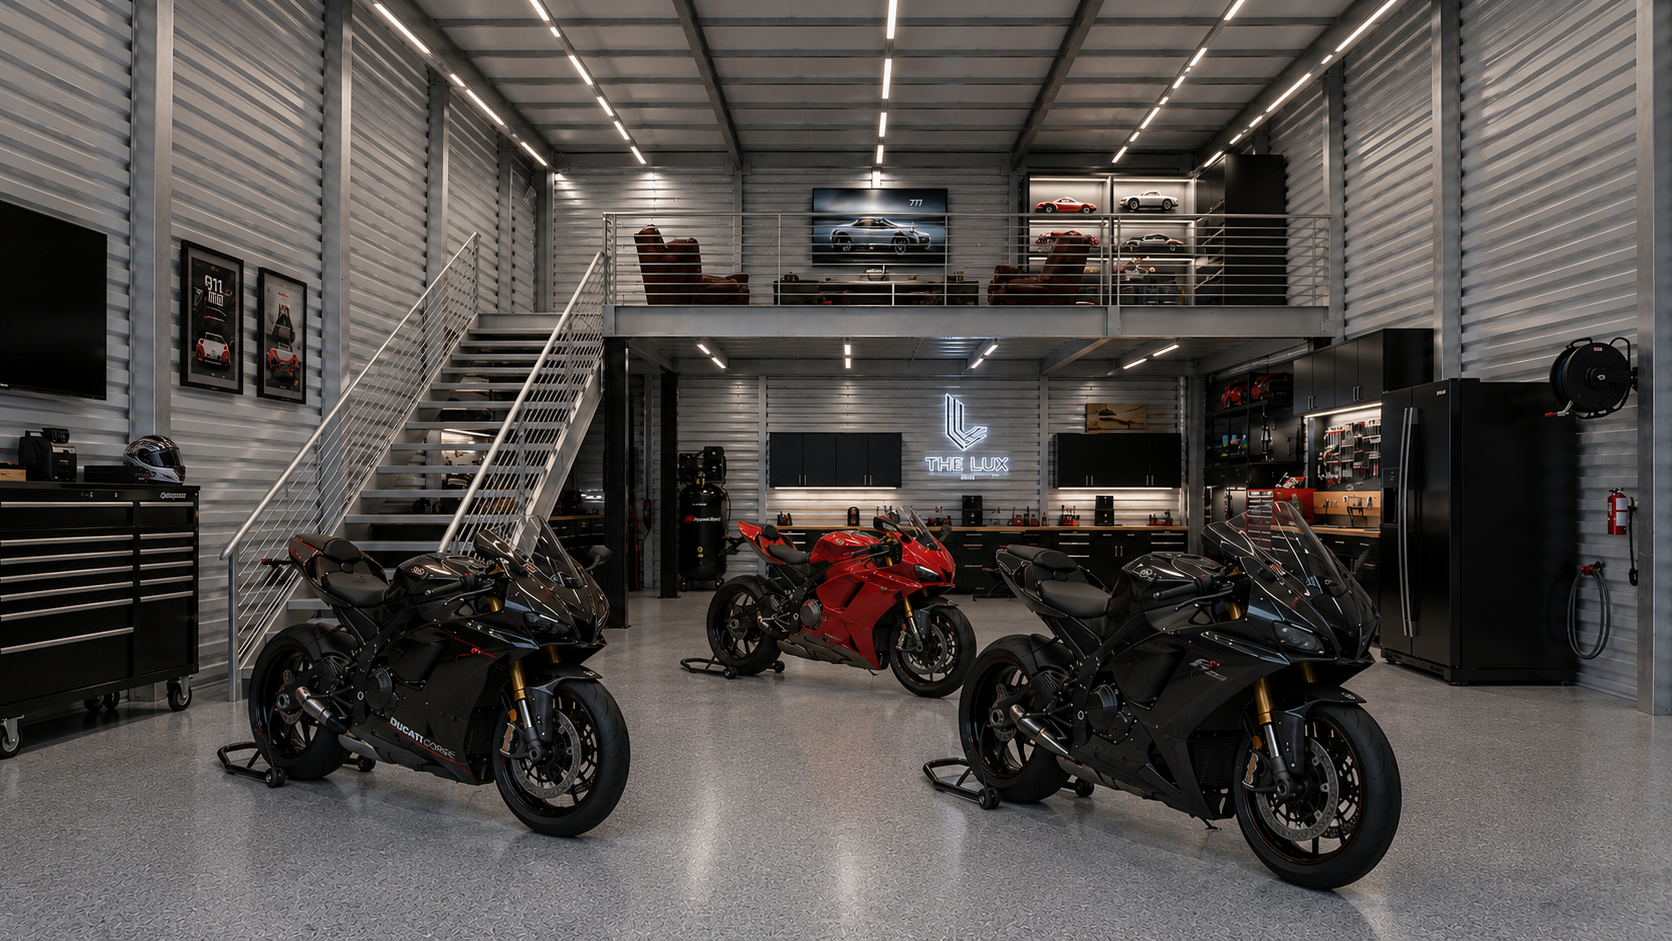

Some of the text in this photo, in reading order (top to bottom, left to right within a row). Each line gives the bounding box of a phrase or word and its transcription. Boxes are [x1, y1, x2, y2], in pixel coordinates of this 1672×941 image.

[204, 274, 223, 293] 911
[925, 456, 1009, 472] THE LUX
